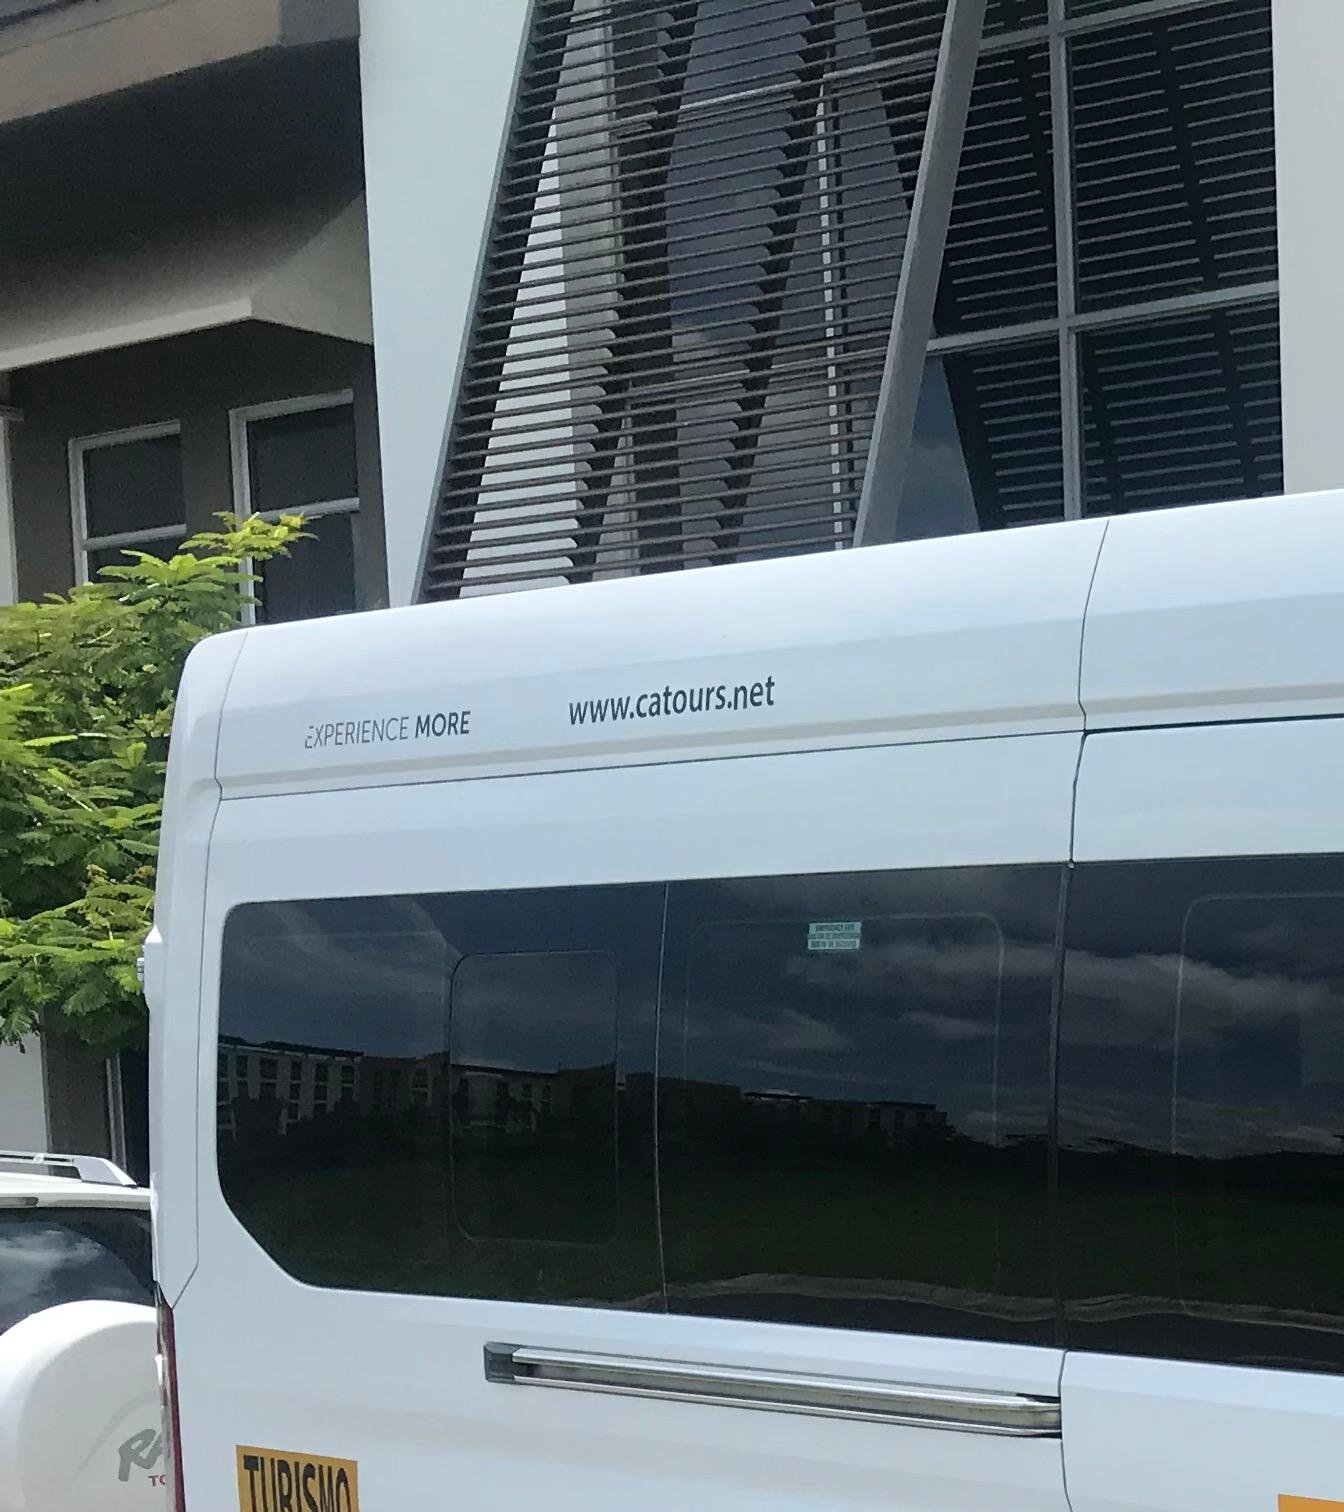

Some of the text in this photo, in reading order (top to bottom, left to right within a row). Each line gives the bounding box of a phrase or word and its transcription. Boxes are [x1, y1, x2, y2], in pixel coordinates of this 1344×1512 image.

[568, 676, 776, 726] www.catours.net
[304, 710, 471, 750] EXPERIENCE MORE
